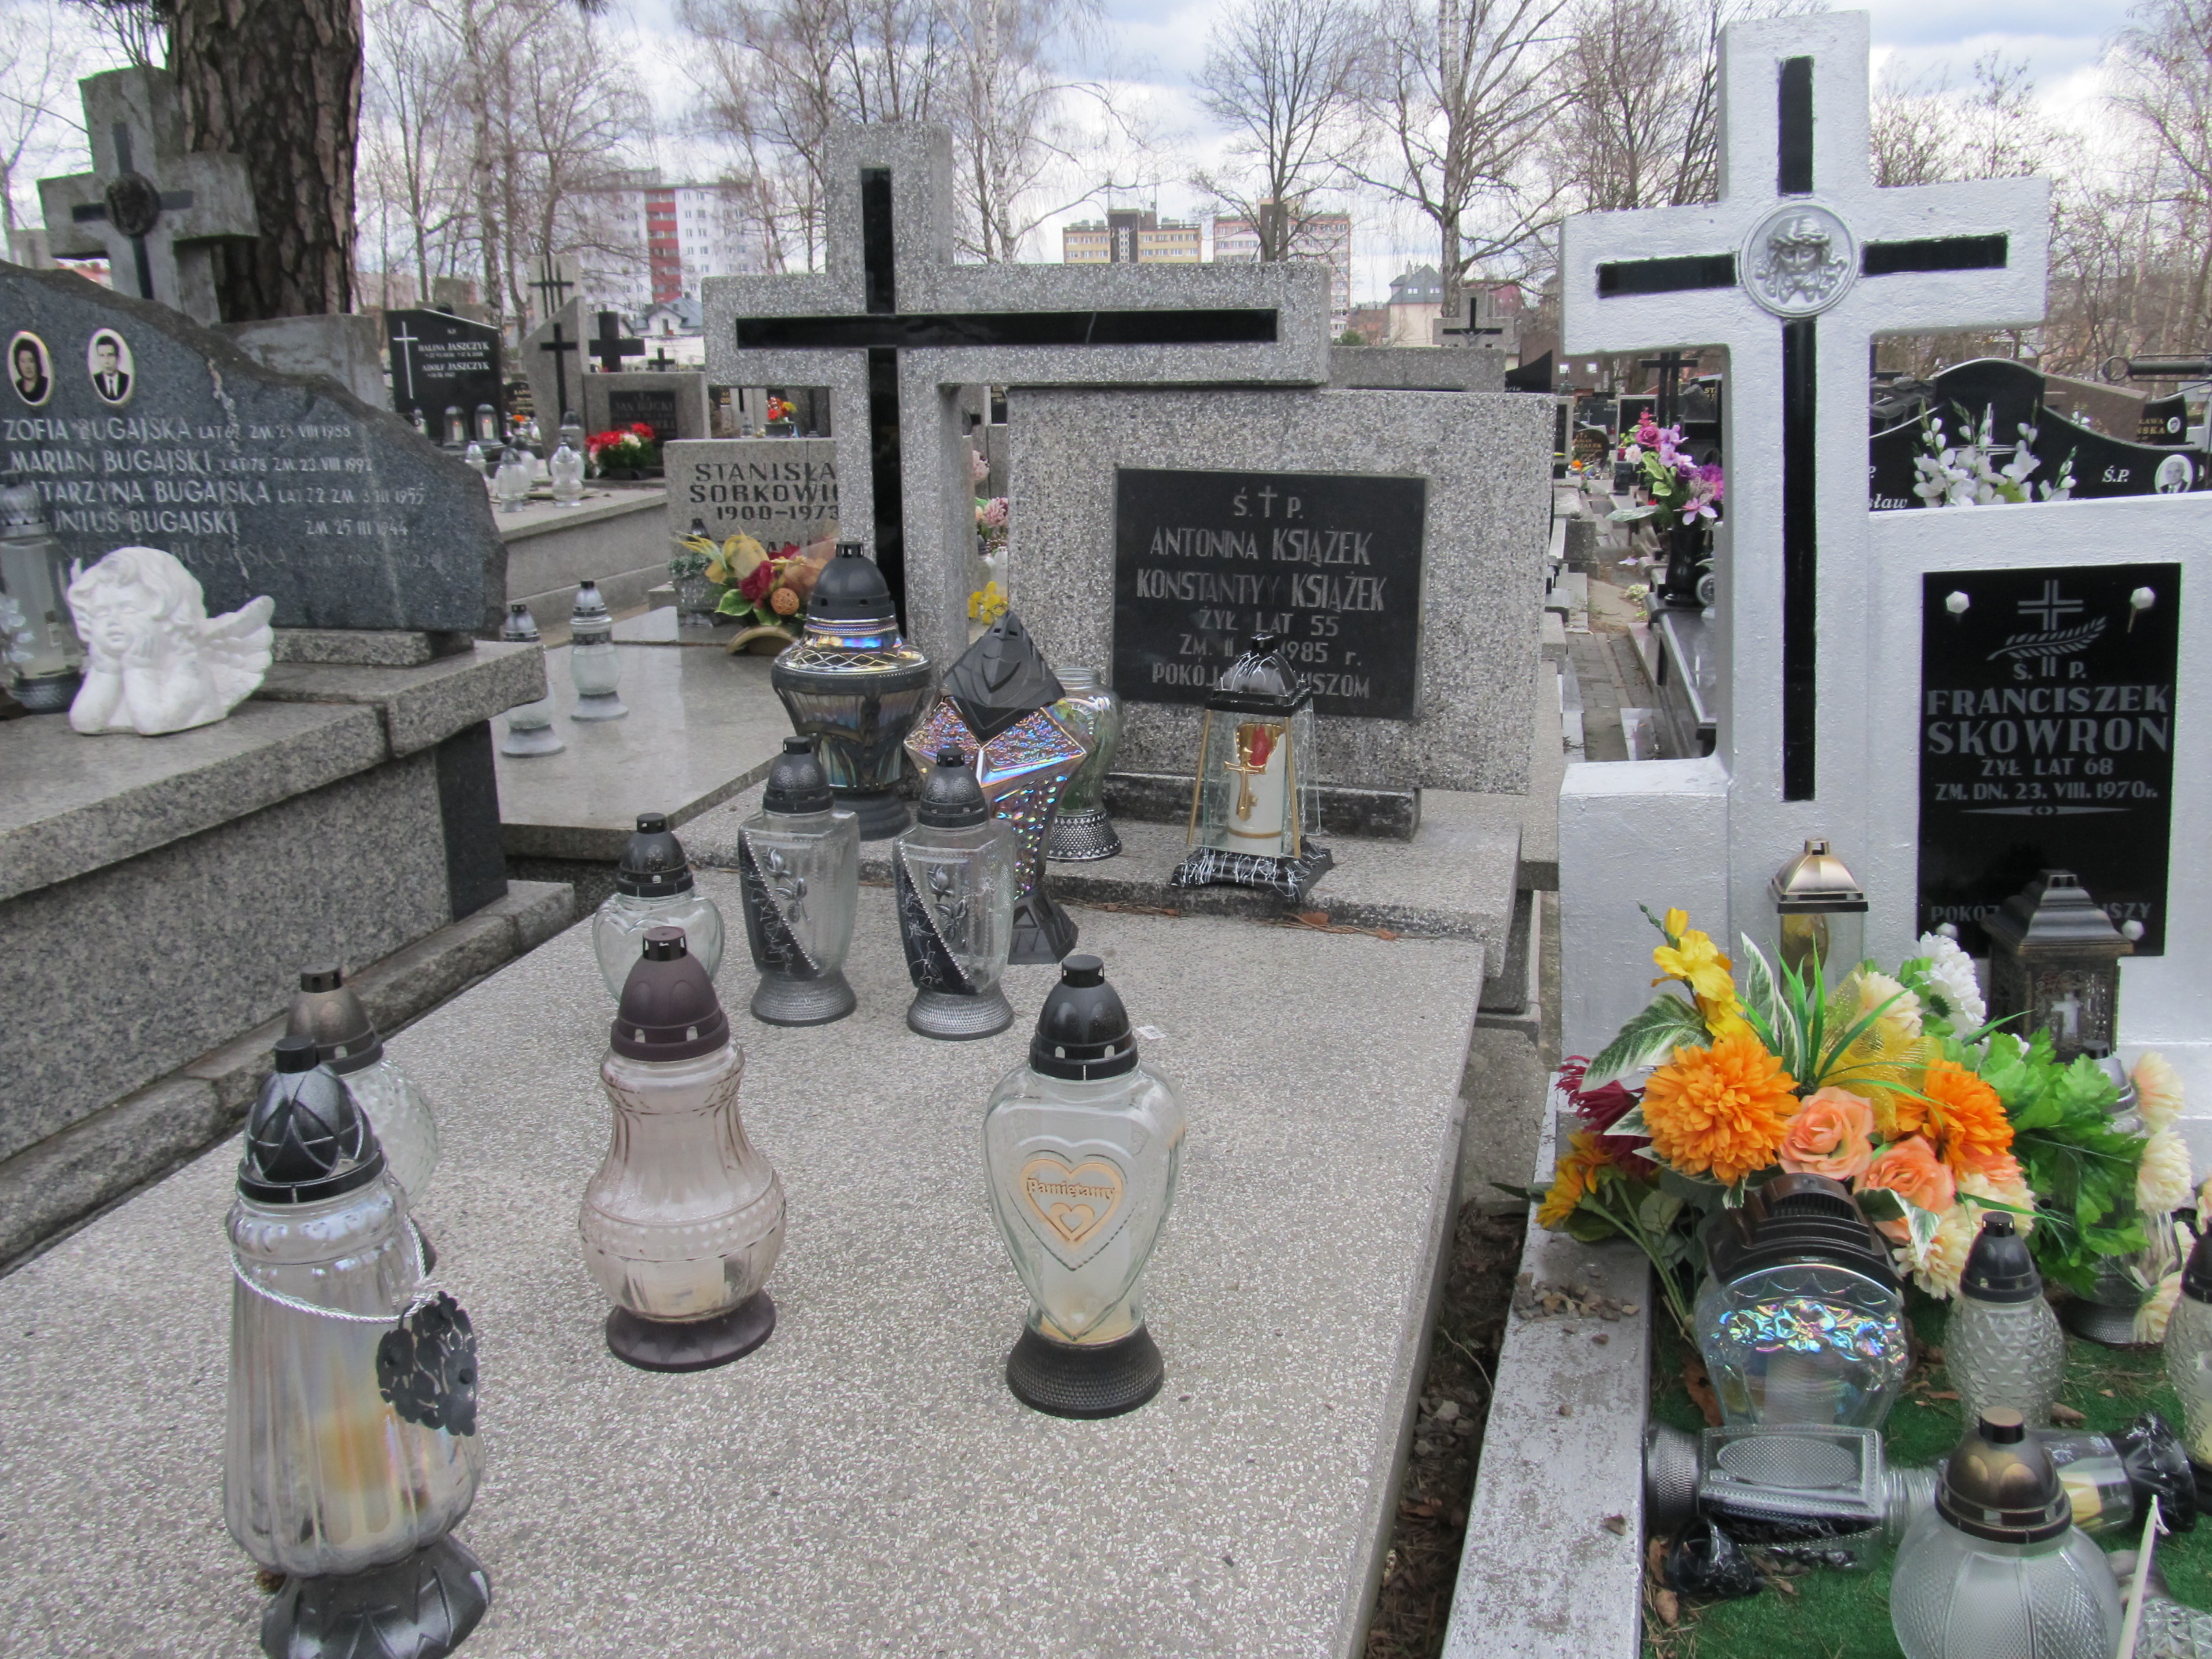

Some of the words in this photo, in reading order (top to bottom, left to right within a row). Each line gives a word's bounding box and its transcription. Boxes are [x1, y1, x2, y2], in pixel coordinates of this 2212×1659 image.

[3, 417, 69, 441] ZOFIA
[79, 417, 192, 443] BUGAJSKA
[199, 426, 222, 438] LAT
[10, 449, 95, 474] MARIAN
[103, 449, 212, 474] BUGAJSKI
[219, 458, 247, 471] LAT
[156, 480, 271, 506] BUGAJSKA
[1287, 496, 1304, 518] P.
[130, 510, 239, 536] BUGAJSKI
[1149, 526, 1259, 560] ANTONINA
[1272, 526, 1373, 566] KSIĄŻEK
[1291, 571, 1387, 613] KSIĄŻEK
[1256, 612, 1295, 634] LAT
[1310, 616, 1340, 637] 55
[1179, 633, 1213, 655] ZM.
[1280, 640, 1328, 663] 1985
[1345, 651, 1363, 666] r.
[1152, 657, 1219, 687] POKÓJ
[2069, 661, 2086, 679] P.
[1926, 685, 2170, 716] FRANCISZEK
[1928, 717, 2169, 756] SKOWRON
[2034, 758, 2075, 775] LAT
[2084, 757, 2114, 775] 68
[1935, 783, 1968, 800] ZM.
[1973, 782, 2009, 800] DN.
[2016, 782, 2048, 800] 23.
[2053, 781, 2093, 799] VIII.
[1027, 1177, 1116, 1200] Pamiętamy
